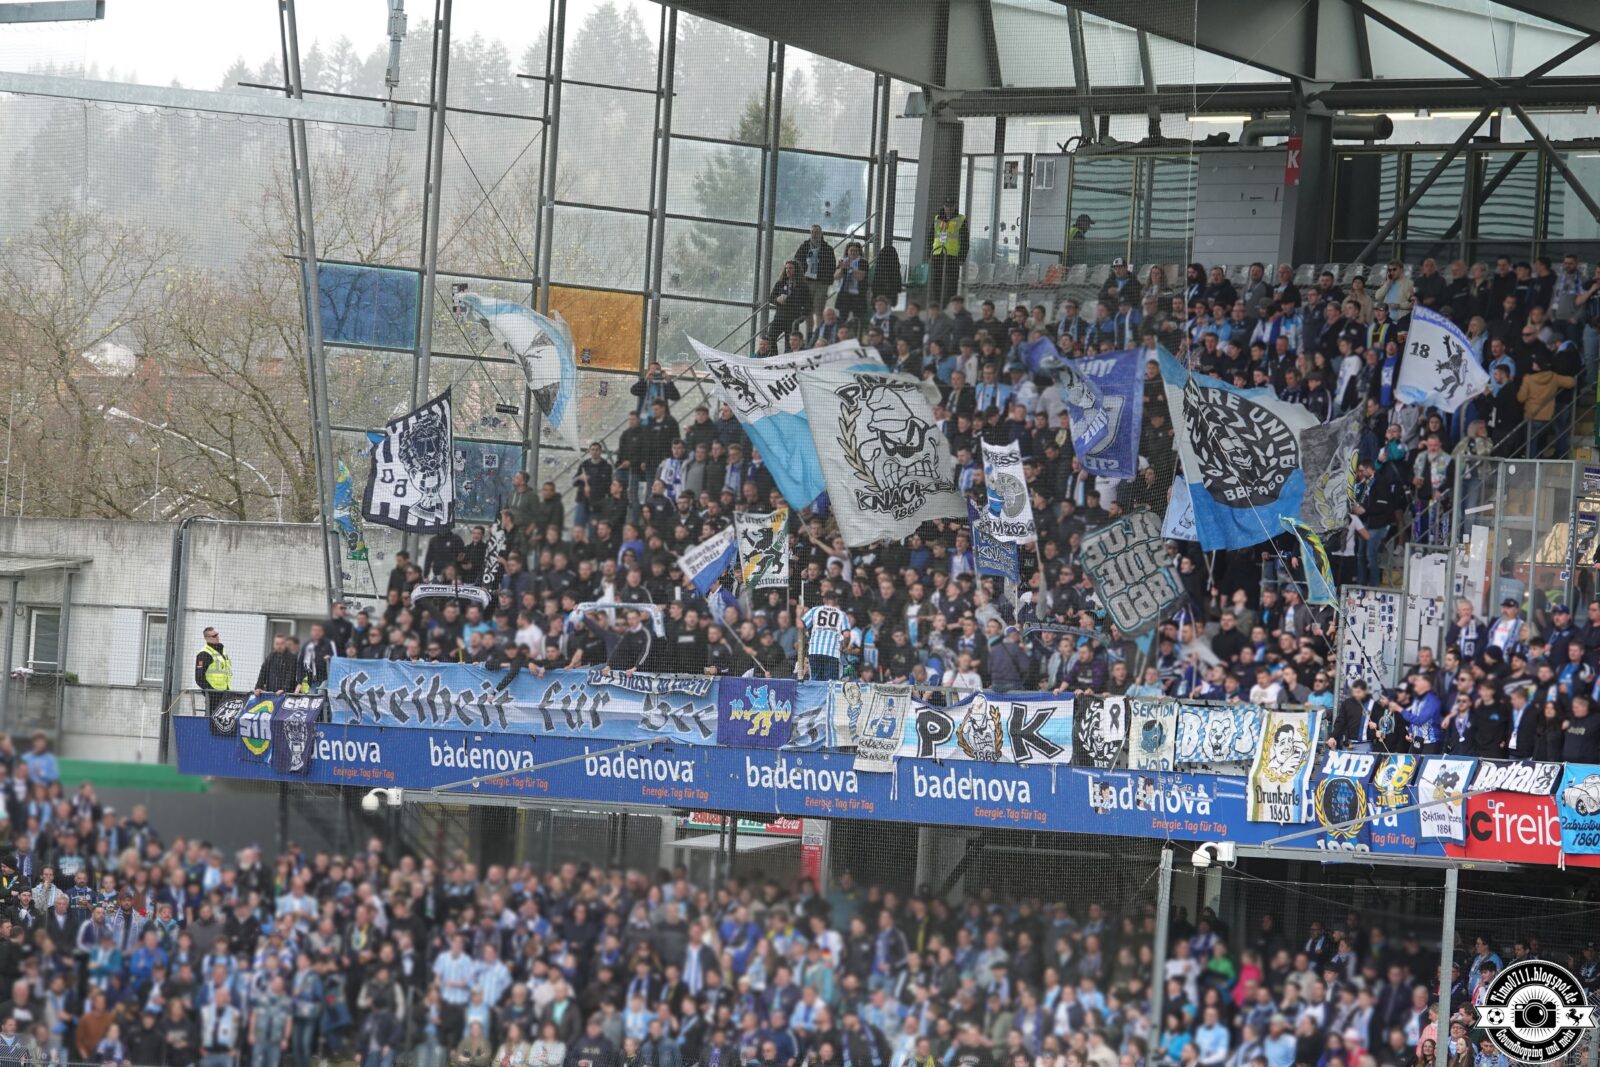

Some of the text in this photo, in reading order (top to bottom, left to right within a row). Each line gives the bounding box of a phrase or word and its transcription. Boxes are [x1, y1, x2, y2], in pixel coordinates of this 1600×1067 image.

[1288, 150, 1300, 168] K
[1410, 342, 1430, 358] 18
[892, 495, 926, 520] 1860
[817, 610, 839, 627] 60
[336, 672, 514, 730] Freiheit
[539, 680, 610, 732] für
[729, 699, 744, 720] 18
[775, 700, 791, 722] 60
[1133, 702, 1175, 718] SEKTION
[915, 703, 1064, 762] P K
[1181, 712, 1202, 757] B
[311, 738, 381, 763] enova
[429, 736, 535, 771] badenova
[973, 750, 1001, 761] 1860
[585, 746, 693, 782] badenova
[1322, 750, 1375, 777] MIB
[333, 767, 395, 780] Energie. Tag für Tag
[746, 756, 858, 793] badenova
[512, 777, 524, 789] Tag
[525, 778, 536, 787] für
[536, 780, 549, 791] Tag
[642, 785, 708, 801] Energie. Tag für Tag
[914, 766, 1031, 803] badenova
[835, 798, 848, 810] Tag
[849, 798, 860, 808] für
[861, 800, 874, 812] Tag
[1269, 805, 1290, 822] 1860
[975, 807, 1047, 823] Energie. Tag für Tag
[1492, 802, 1562, 846] freib
[1152, 818, 1227, 836] Energie. Tag für Tag
[1371, 832, 1416, 848] Tag für Tag
[1572, 833, 1600, 846] 1860
